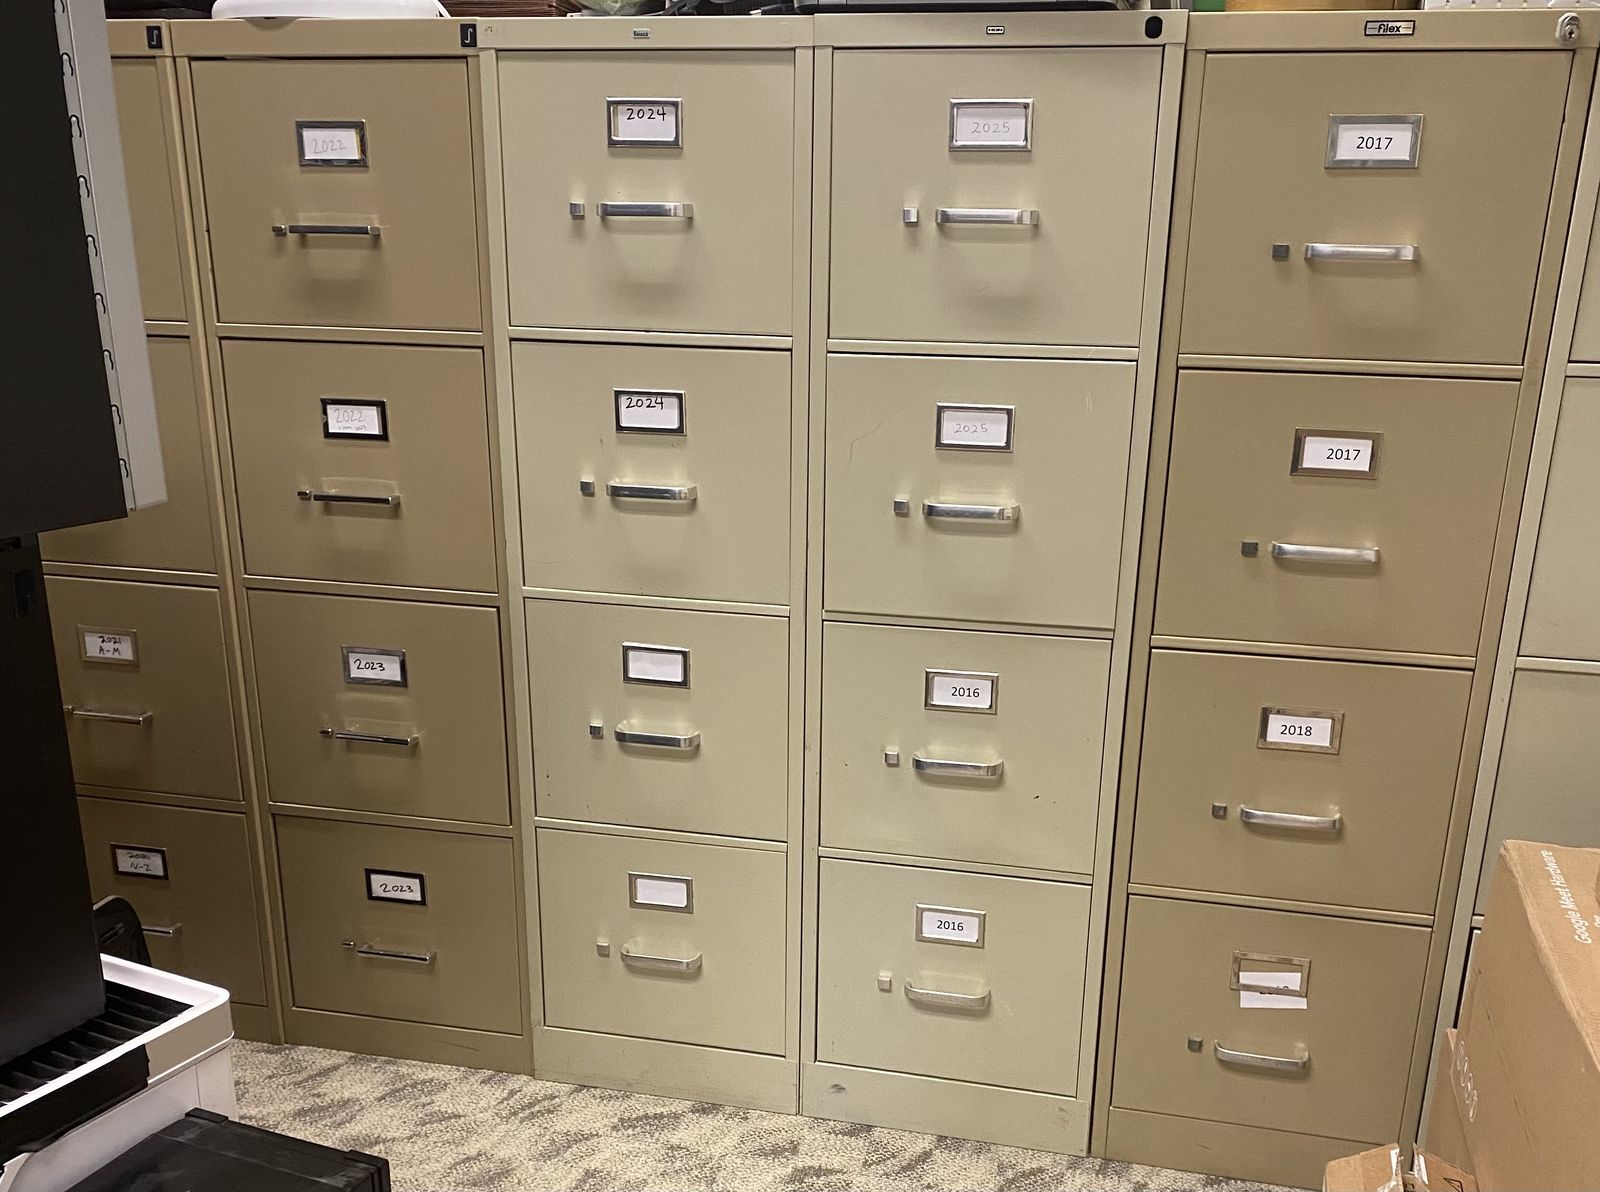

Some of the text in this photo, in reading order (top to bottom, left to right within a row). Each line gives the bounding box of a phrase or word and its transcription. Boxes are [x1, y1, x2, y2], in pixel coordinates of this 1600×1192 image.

[1377, 23, 1402, 34] filex
[625, 106, 668, 122] 2024
[971, 121, 1010, 135] 2025
[311, 137, 348, 155] 2022
[1355, 135, 1394, 151] 2017
[625, 394, 665, 411] 2024
[334, 407, 367, 423] 2022
[952, 422, 989, 434] 2025
[1325, 447, 1362, 461] 2017
[98, 635, 122, 645] 2021
[353, 656, 386, 672] 2023
[951, 686, 980, 698] 2016
[1279, 724, 1313, 737] 2018
[378, 882, 415, 894] 2023
[1541, 850, 1592, 944] Google Meet Hardware
[936, 919, 965, 932] 2016
